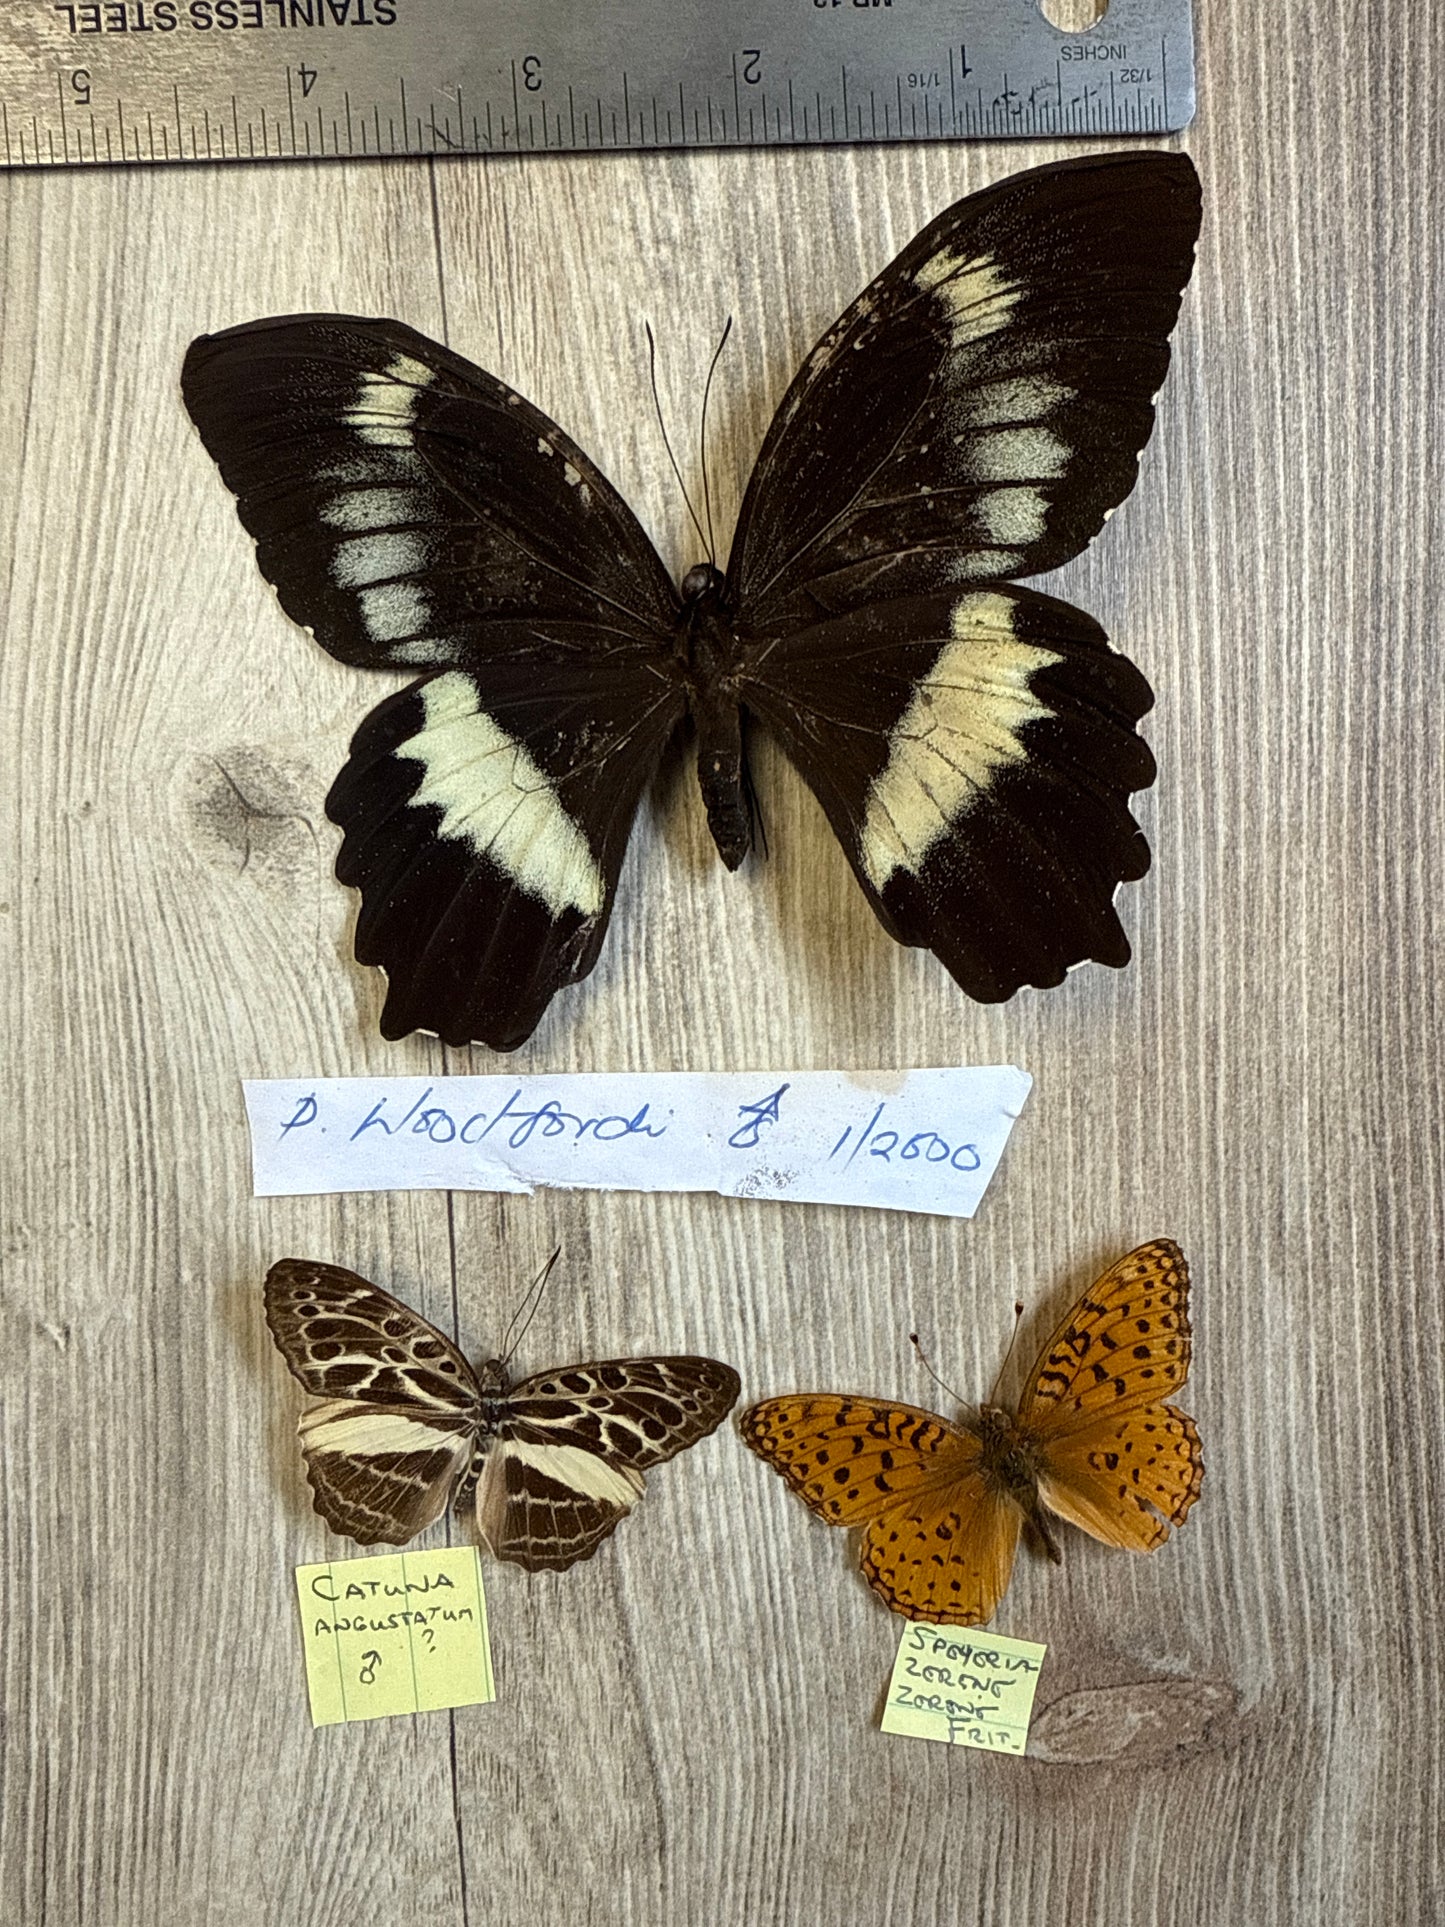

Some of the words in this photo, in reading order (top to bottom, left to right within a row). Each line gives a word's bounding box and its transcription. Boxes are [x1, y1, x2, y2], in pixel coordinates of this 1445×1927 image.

[54, 0, 178, 33] STEEL
[191, 0, 398, 31] STAINLESS
[742, 50, 761, 84] 2
[1060, 44, 1127, 62] INCHES
[71, 69, 91, 105] 5
[298, 62, 318, 98] 4
[522, 56, 542, 91] 3
[907, 73, 941, 89] 1/16
[1119, 69, 1153, 84] 1/32
